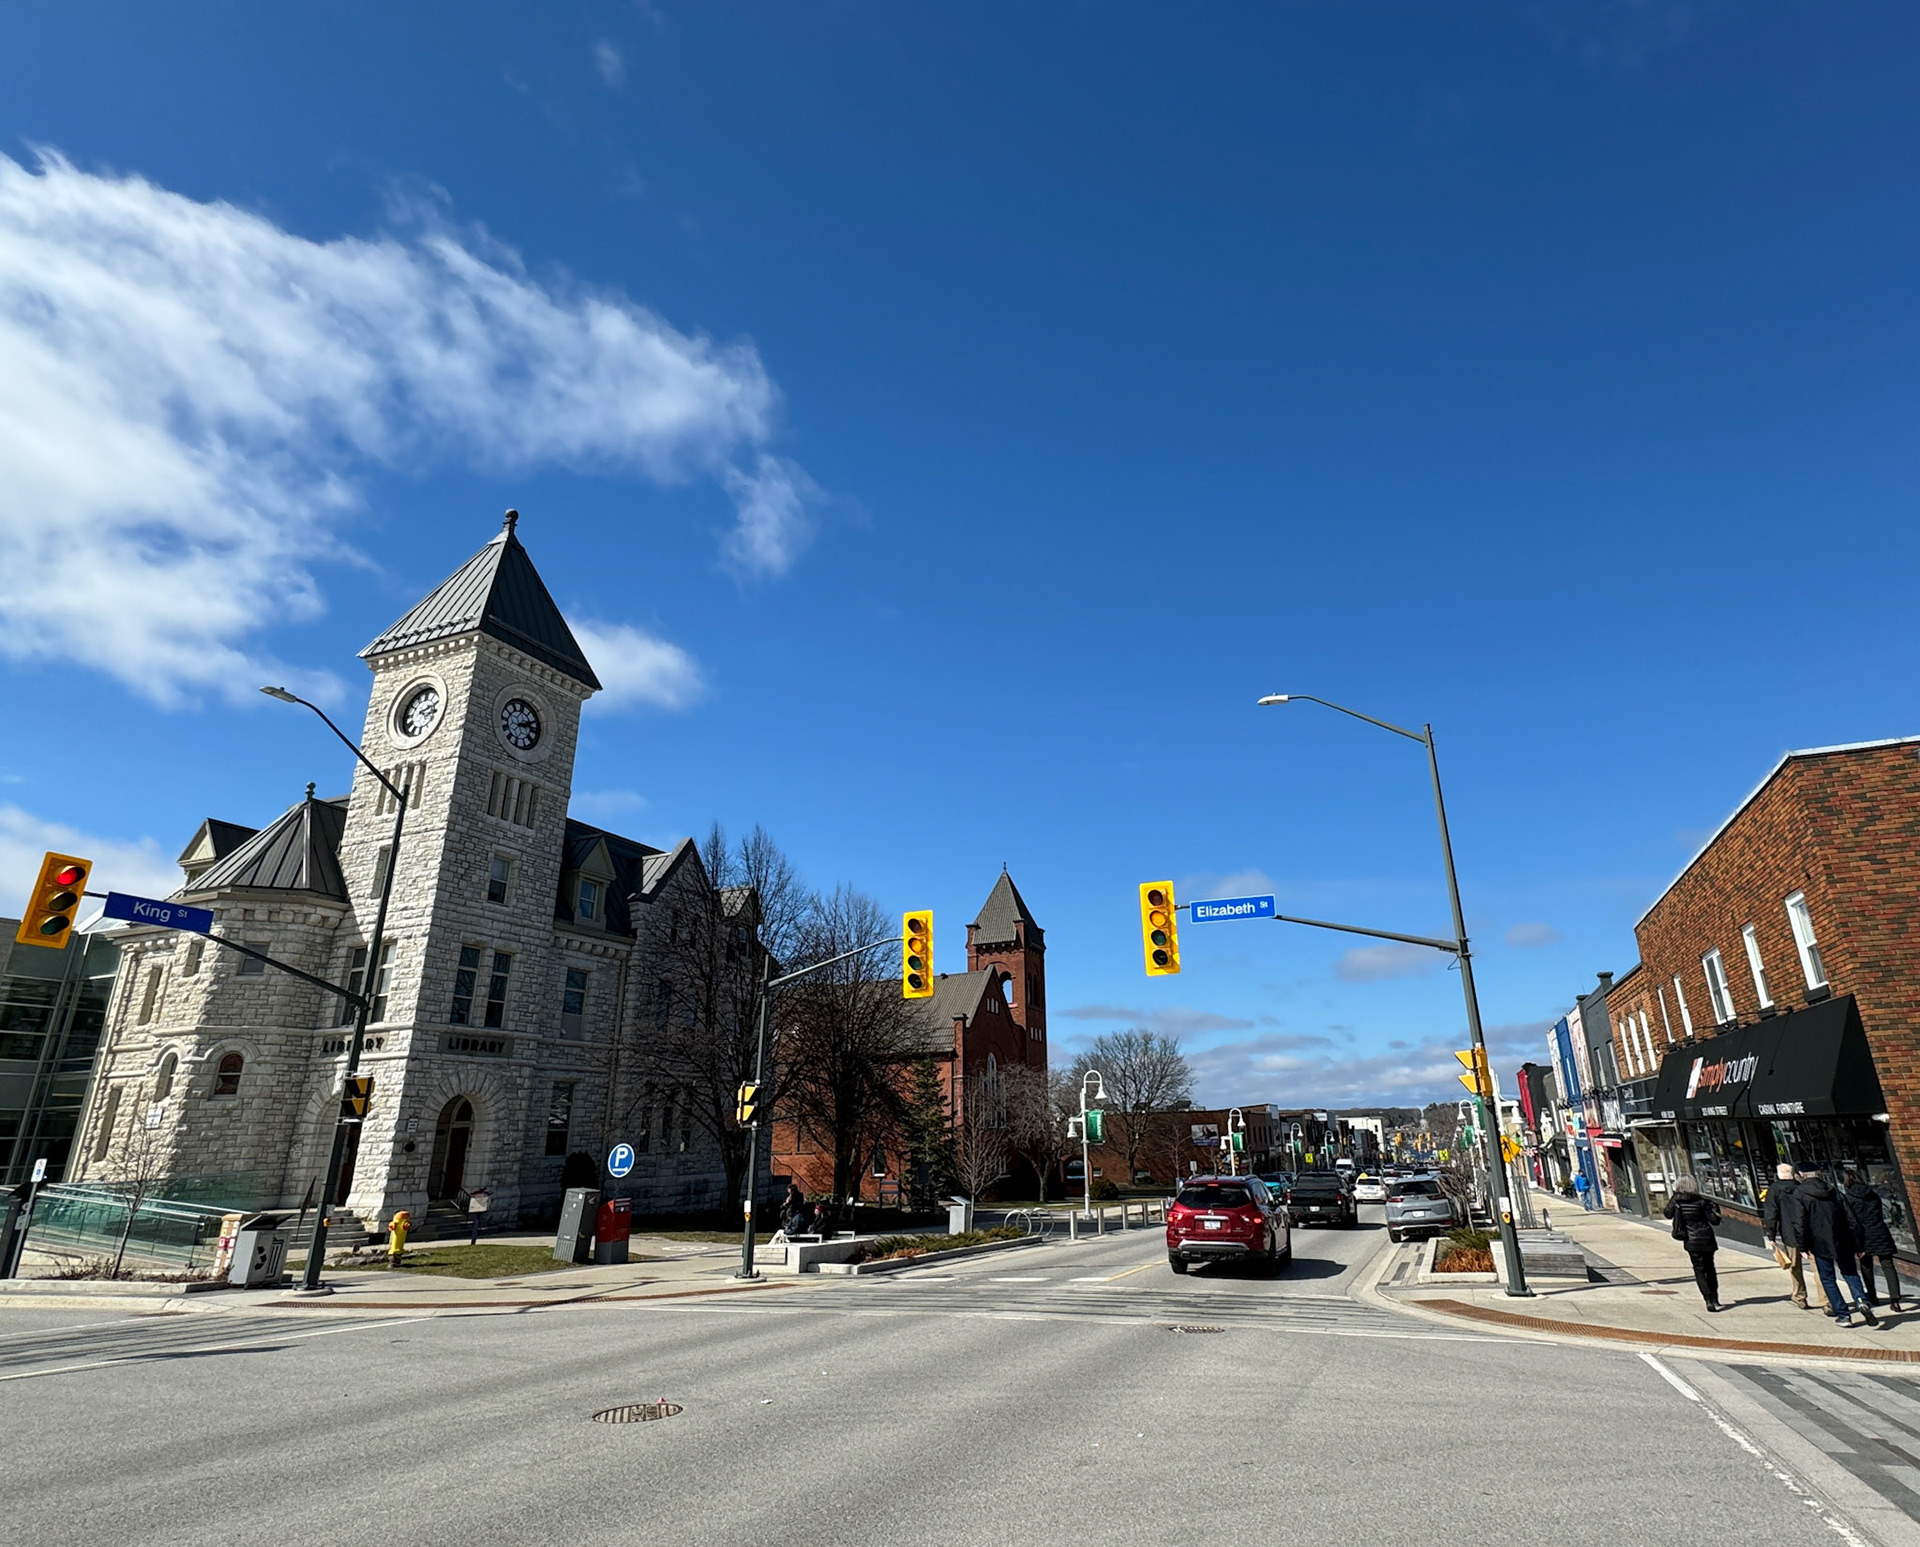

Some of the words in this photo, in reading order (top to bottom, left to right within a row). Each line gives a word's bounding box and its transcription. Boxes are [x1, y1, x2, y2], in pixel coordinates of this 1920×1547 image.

[133, 902, 171, 923] King
[177, 909, 188, 918] St
[1197, 903, 1255, 917] Elizabeth
[1259, 901, 1269, 909] St
[323, 1037, 385, 1053] LIBRY
[448, 1037, 505, 1054] LIBRARY
[615, 1147, 629, 1167] P
